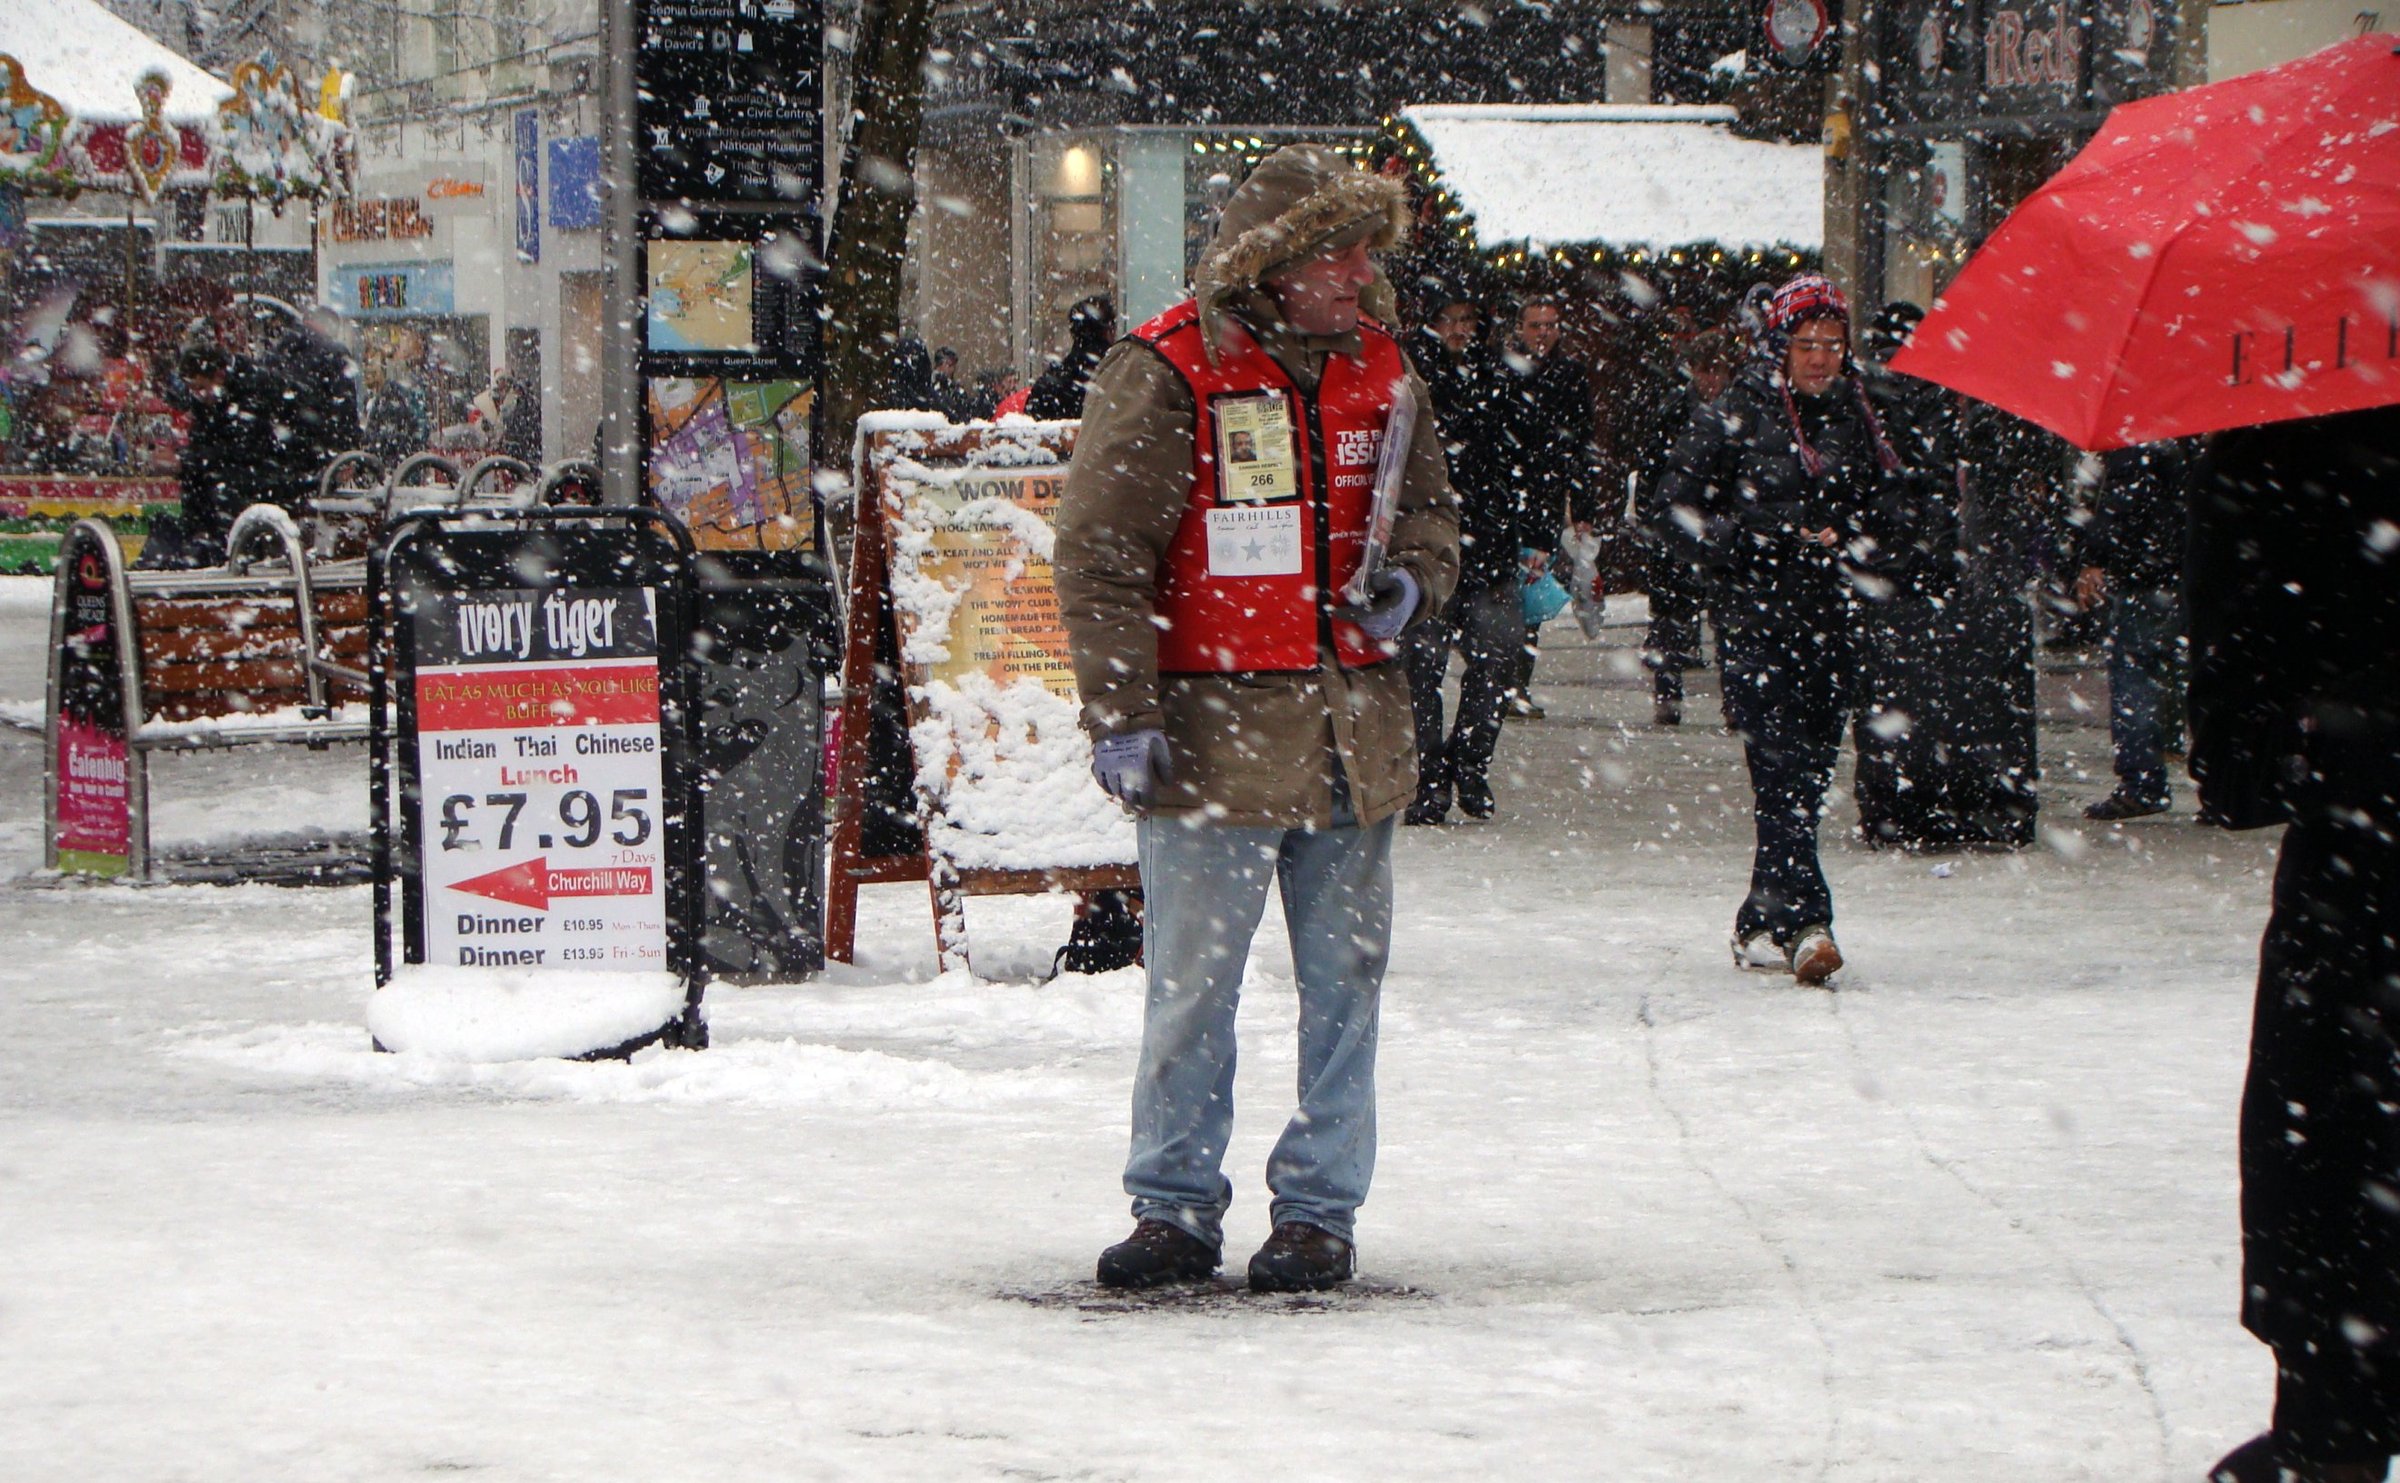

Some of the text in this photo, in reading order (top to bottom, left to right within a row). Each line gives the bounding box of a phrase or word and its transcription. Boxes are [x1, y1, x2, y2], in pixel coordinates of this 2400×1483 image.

[650, 4, 735, 18] Sophia Gardens
[664, 38, 704, 50] David's
[746, 107, 813, 119] Civic Centre
[719, 139, 812, 153] National Museum
[742, 174, 768, 186] New
[723, 356, 751, 366] Queen
[1336, 430, 1369, 443] THE
[1337, 442, 1382, 466] ISSU
[1251, 473, 1274, 487] 266
[1335, 474, 1367, 488] OFFICIAL
[954, 479, 1024, 501] WOW
[1213, 510, 1291, 522] FAIRHILLS
[972, 548, 994, 557] AND
[996, 548, 1013, 556] ALL
[971, 601, 989, 610] THE
[1027, 599, 1051, 607] CLUB
[543, 593, 617, 657] tiger
[981, 613, 1039, 623] HOMEMADE
[1010, 625, 1042, 634] BREAD
[974, 651, 1005, 661] FRESH
[1008, 649, 1050, 659] FILLINGS
[1003, 663, 1020, 673] ON
[1023, 663, 1042, 672] THE
[425, 678, 655, 702] EAT AS MUCH AS YOU LIKE
[507, 702, 576, 720] BUFF
[436, 733, 655, 760] Indian Thai Chinese
[501, 764, 578, 786] Lunch
[440, 788, 652, 852] £7.95
[622, 850, 656, 864] Days
[548, 871, 647, 893] Churchill Way
[457, 914, 545, 935] Dinner
[563, 919, 604, 932] £10.95
[460, 947, 545, 967] Dinner
[563, 947, 604, 960] £13.95
[612, 946, 630, 959] Fri
[639, 946, 661, 959] Sun
